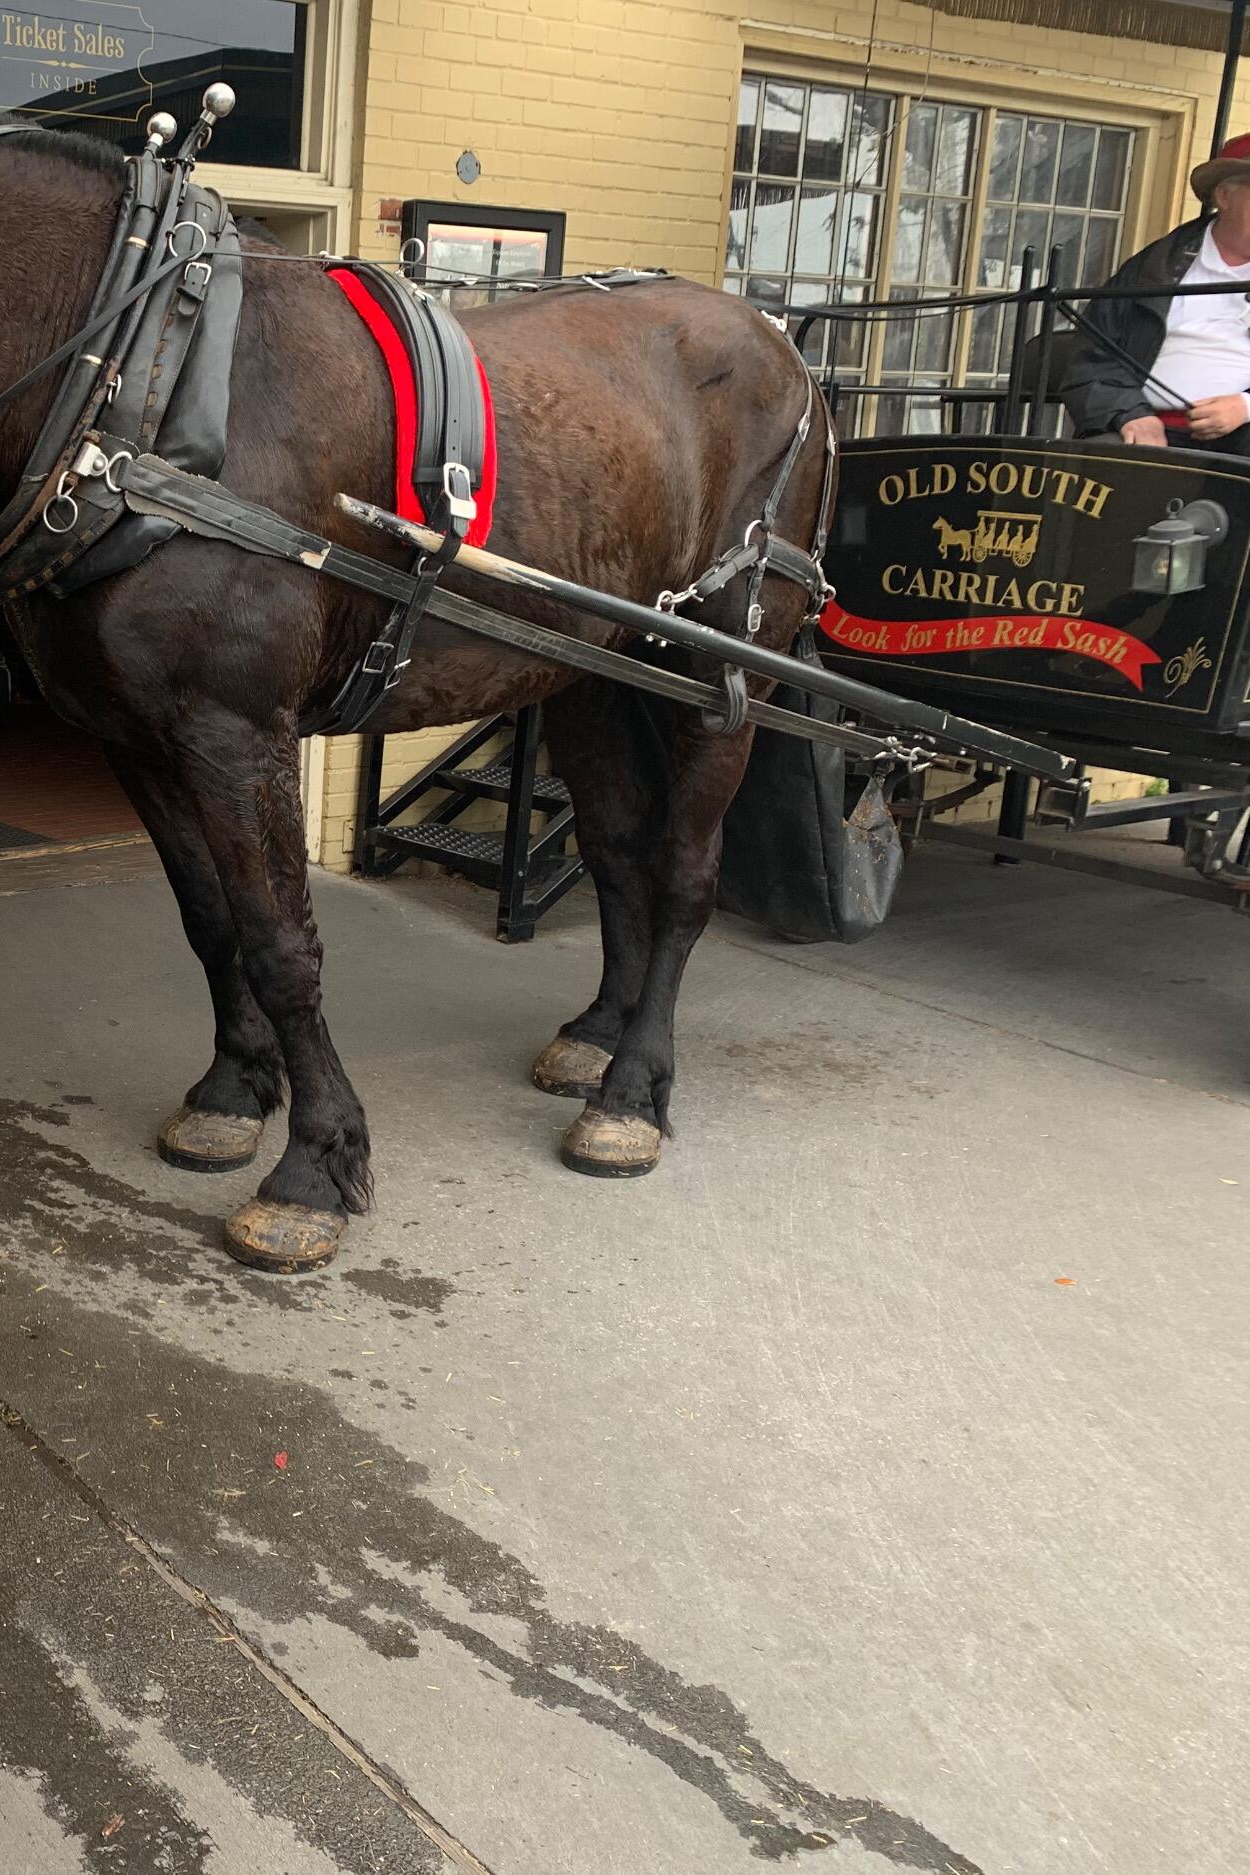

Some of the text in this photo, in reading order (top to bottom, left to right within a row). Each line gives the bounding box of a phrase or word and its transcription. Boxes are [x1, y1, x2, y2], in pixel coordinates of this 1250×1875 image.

[2, 14, 125, 59] Ticket Sales
[30, 72, 97, 95] INSIDE
[878, 461, 1115, 519] OLD SOUTH
[881, 564, 1086, 617] CARRIAGE
[831, 614, 1128, 664] Look for the Red Sash
